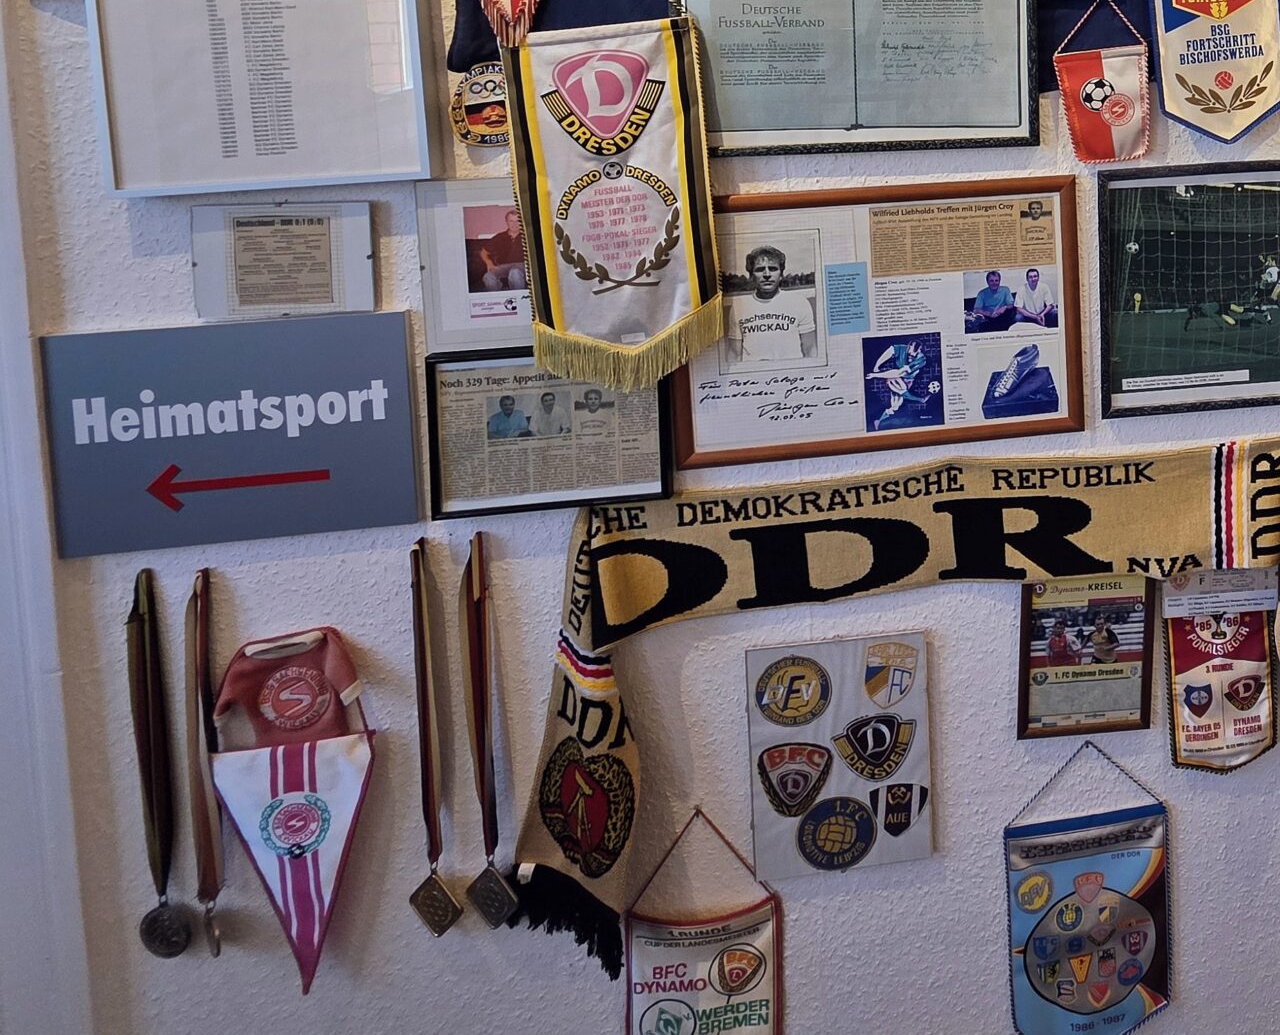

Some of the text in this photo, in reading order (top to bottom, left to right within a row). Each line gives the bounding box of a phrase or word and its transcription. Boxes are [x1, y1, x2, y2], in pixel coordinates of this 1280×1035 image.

[1210, 23, 1231, 36] BSG
[1186, 33, 1257, 52] FORTSCHRITT
[1179, 46, 1265, 65] BISCHOFSWERDA
[560, 108, 652, 156] DRESDEN
[556, 165, 678, 220] DYNAMO DRESDEN
[581, 197, 614, 209] MEISTER
[615, 195, 631, 204] DER
[872, 203, 1014, 218] Wilfried Liebholds Treffen mit Jürgen Croy
[739, 313, 796, 326] Sachsenring
[742, 323, 790, 334] ZWICKAU
[440, 373, 545, 390] Noch 329 Tage: Appetit
[72, 379, 388, 445] Heimatsport
[676, 461, 1156, 528] DEMOKRATISCHE REPUBLIK
[590, 494, 1113, 653] DDR
[1126, 553, 1203, 577] NVA
[1187, 625, 1251, 656] POKALSIEGER
[761, 674, 817, 709] DFV
[1233, 714, 1261, 726] DYNAMO
[1185, 732, 1219, 743] UERDINGEN
[1233, 725, 1263, 736] DRESDEN
[766, 745, 827, 769] BFC
[846, 742, 909, 779] DRESDEN
[886, 812, 908, 824] AUE
[1020, 880, 1047, 907] DFV
[652, 963, 688, 980] BFC
[634, 978, 707, 995] DYNAMO
[696, 998, 770, 1022] WERDER
[698, 1012, 769, 1035] BREMEN
[1070, 1014, 1126, 1032] 1986 1987
